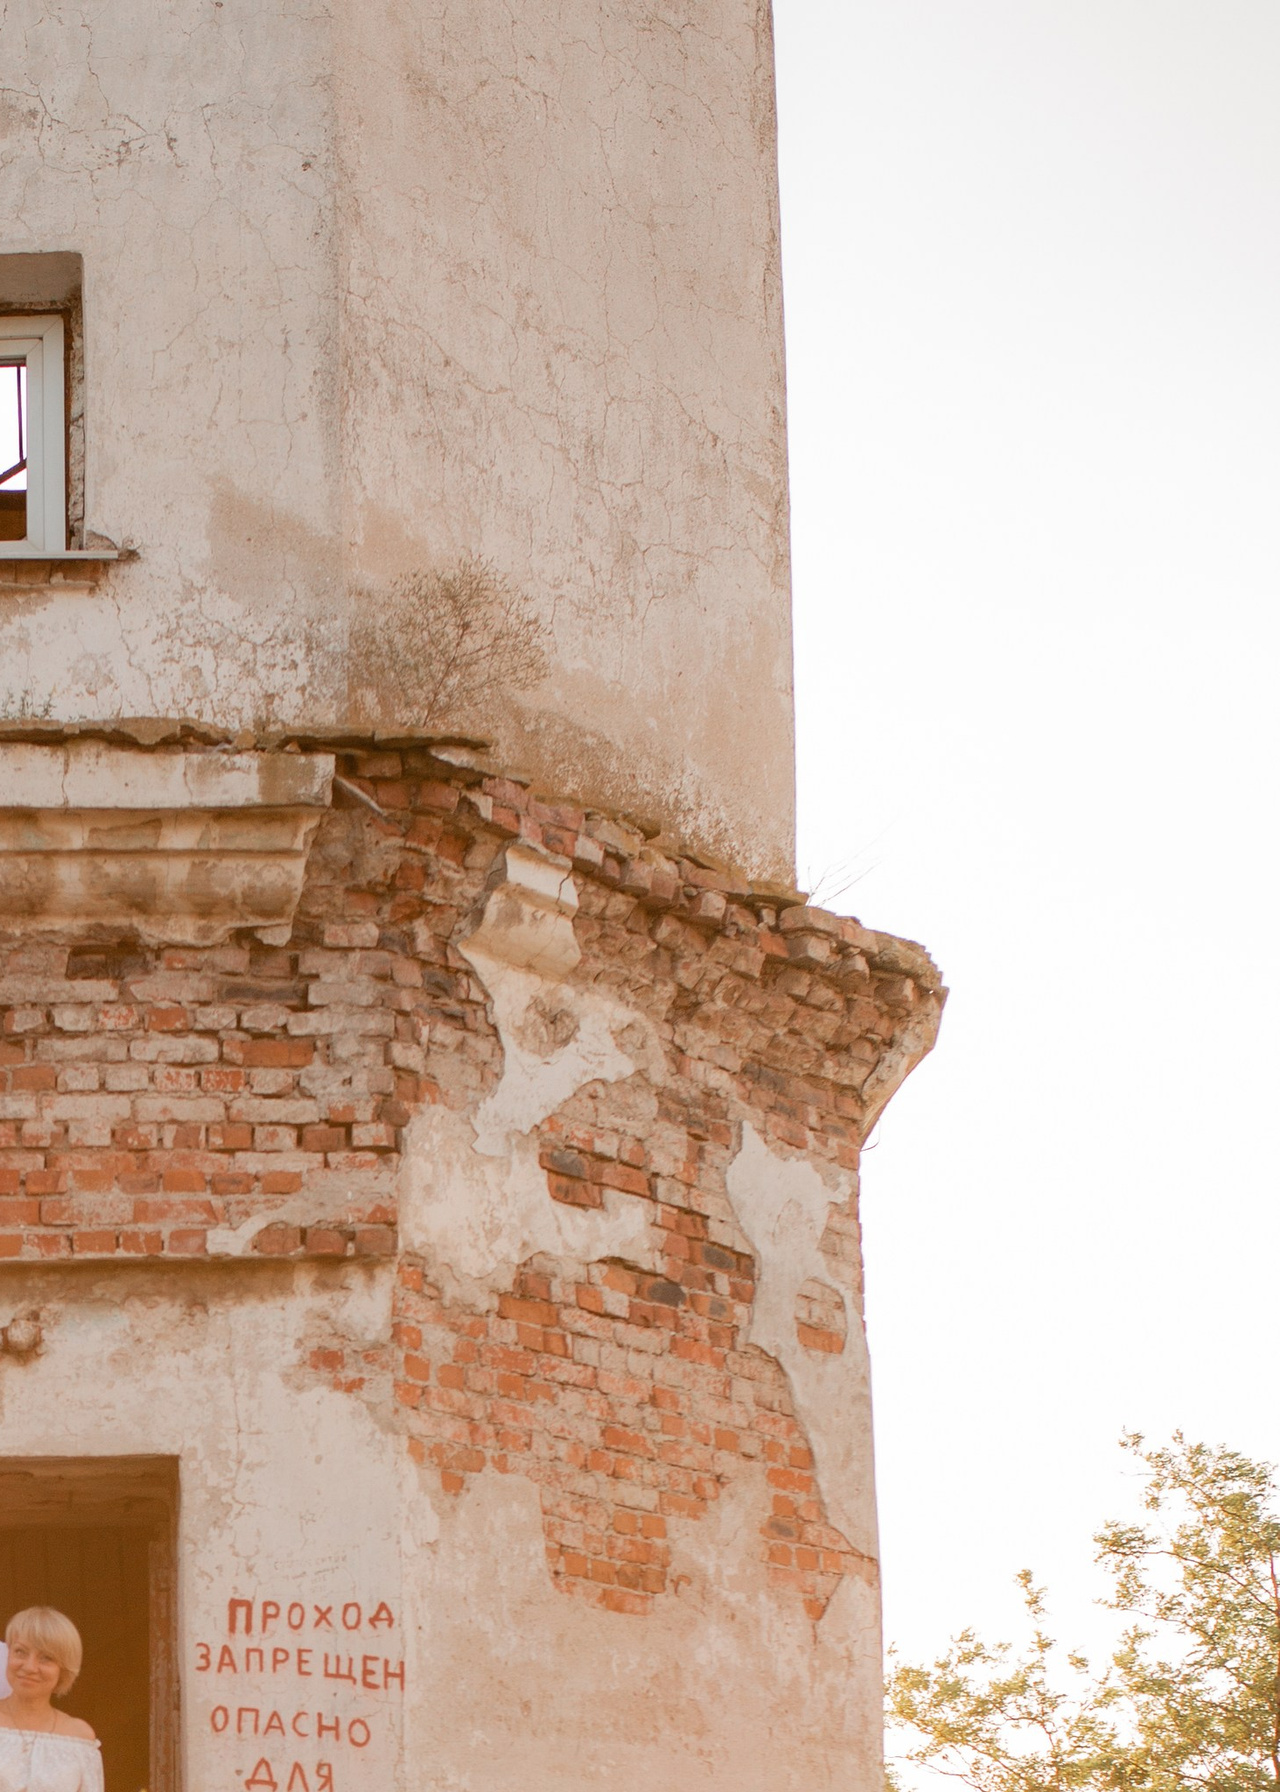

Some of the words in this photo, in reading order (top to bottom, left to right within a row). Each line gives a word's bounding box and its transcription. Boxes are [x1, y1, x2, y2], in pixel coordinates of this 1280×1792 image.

[227, 1597, 395, 1636] ПРОХОД
[195, 1642, 405, 1692] ЗАПРЕЩЕН
[209, 1705, 371, 1749] ОПАСНО
